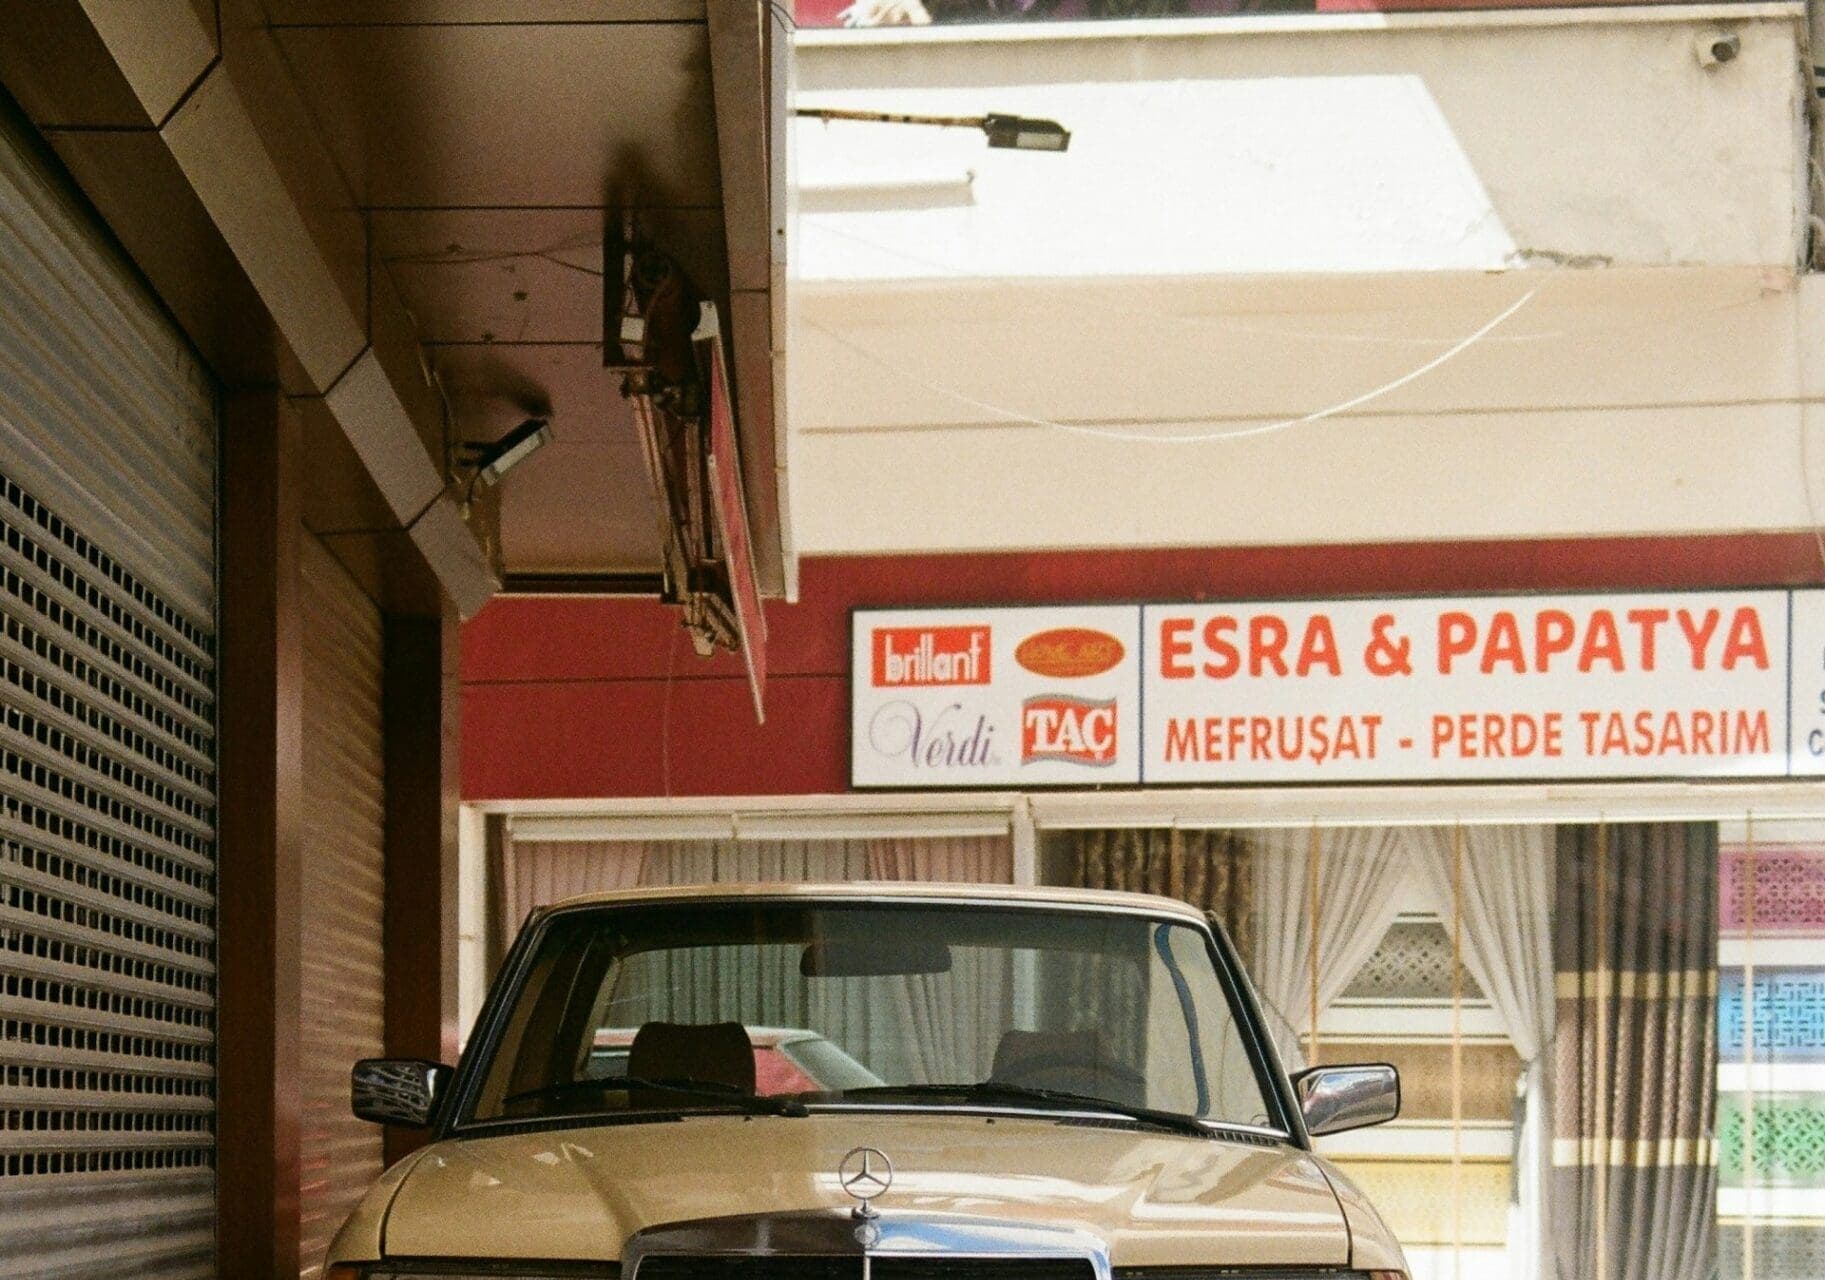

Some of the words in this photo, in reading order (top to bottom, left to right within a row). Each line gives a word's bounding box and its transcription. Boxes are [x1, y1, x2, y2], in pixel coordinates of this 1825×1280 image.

[885, 632, 982, 682] brillant
[1158, 612, 1342, 681] ESRA
[1363, 612, 1414, 678] &
[1436, 605, 1770, 676] PAPATYA
[869, 699, 995, 768] Verdi
[1164, 713, 1383, 766] MEFRUŞAT
[1431, 711, 1563, 759] PERDE
[1578, 709, 1771, 757] TASARIM
